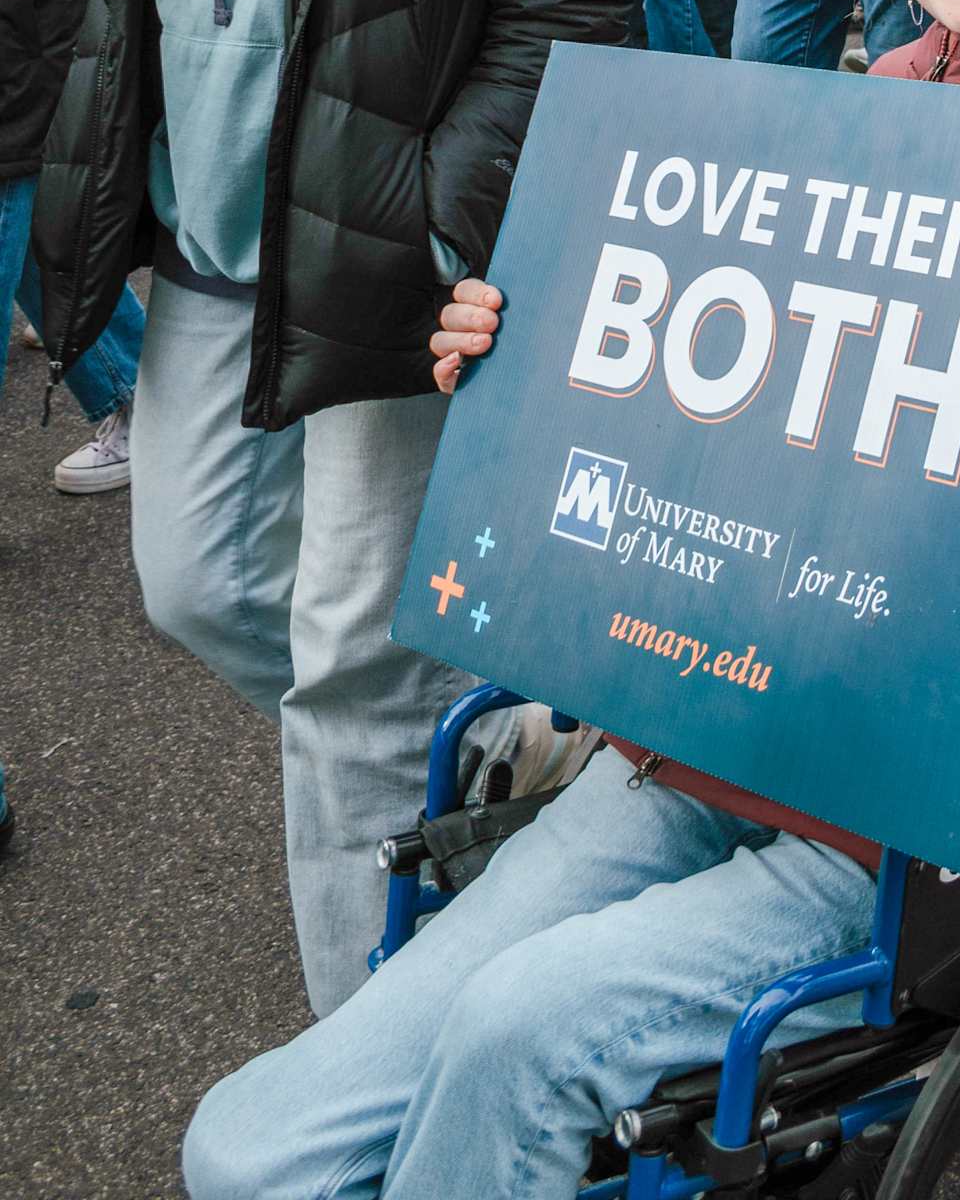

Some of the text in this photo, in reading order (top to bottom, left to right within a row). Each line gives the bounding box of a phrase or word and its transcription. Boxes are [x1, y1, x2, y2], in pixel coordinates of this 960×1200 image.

[608, 149, 790, 246] LOVE
[616, 526, 725, 585] of MARY
[622, 483, 891, 620] UNIVERSITY for Life.
[608, 611, 773, 692] umary.edu
